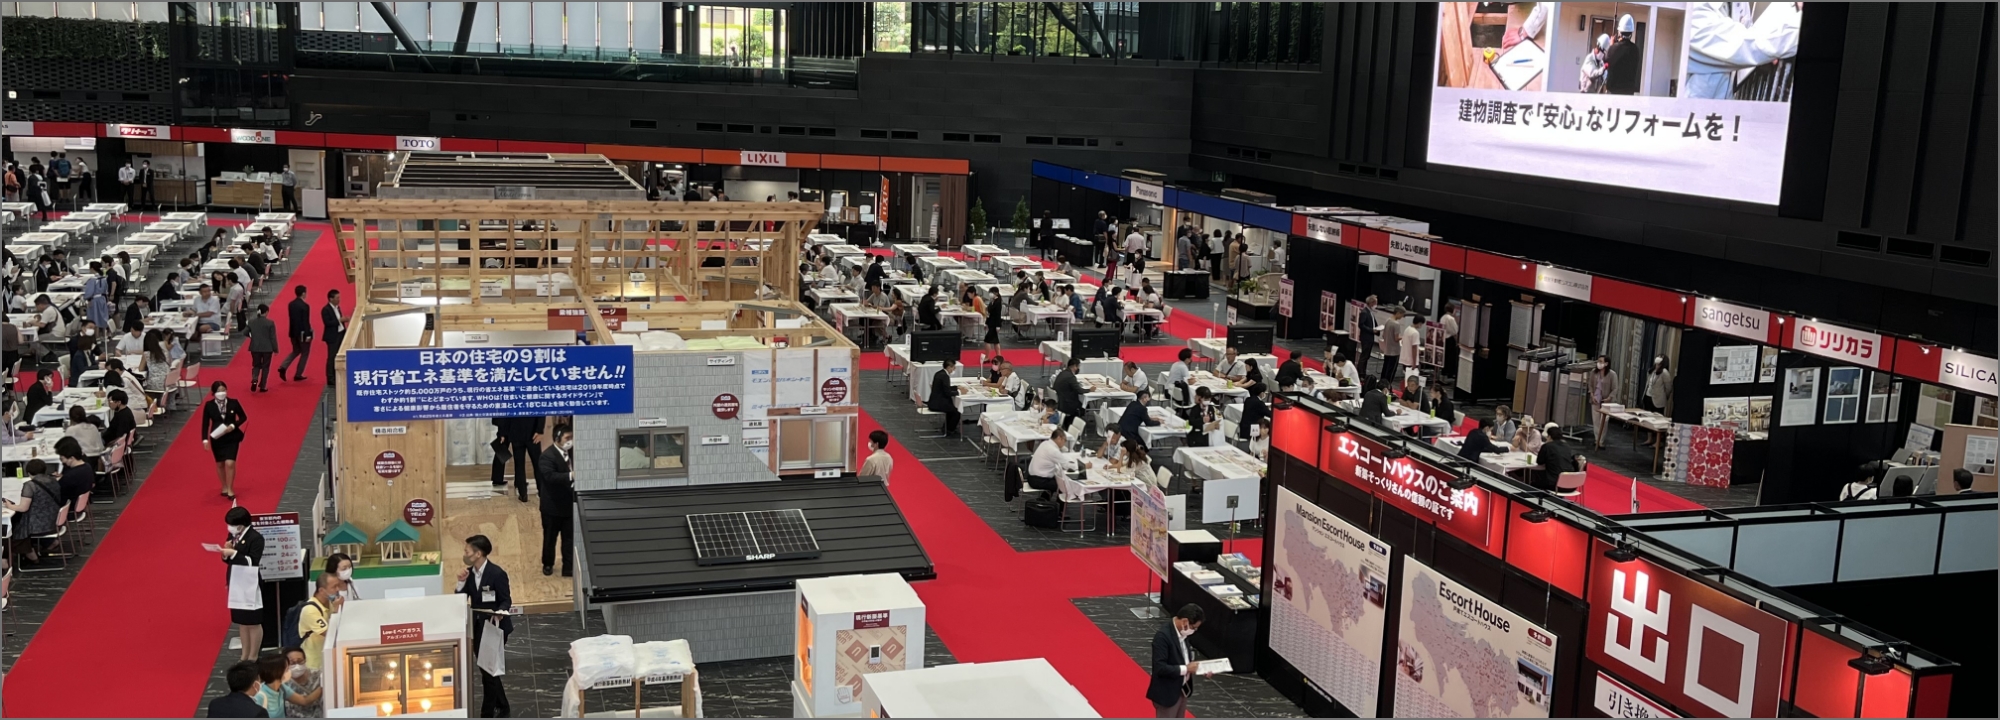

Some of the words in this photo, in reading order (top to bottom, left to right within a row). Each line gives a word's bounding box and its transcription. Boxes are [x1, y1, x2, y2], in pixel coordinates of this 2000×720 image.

[1458, 98, 1741, 142] 建物調査で「安心」なリフォームを！
[402, 138, 435, 149] TOTO
[747, 153, 780, 164] LIXIL
[1702, 305, 1761, 331] sangetsu
[419, 348, 567, 366] 日本の住宅の9割は
[1819, 330, 1874, 359] リリカラ
[353, 365, 627, 386] 現行省エネ基準を満たしていません!!
[1337, 436, 1479, 516] エスコートハウスのご案内
[1354, 464, 1455, 521] 新築そっくりさんの信頼の証です
[1296, 503, 1322, 528] Mansion
[1322, 518, 1345, 541] Escort
[1343, 529, 1366, 552] House
[745, 553, 776, 562] SHARP
[1438, 581, 1473, 613] Escort
[1474, 599, 1511, 634] House
[317, 618, 327, 628] 3
[1603, 568, 1760, 718] 出口
[1608, 689, 1660, 718] 引き換
